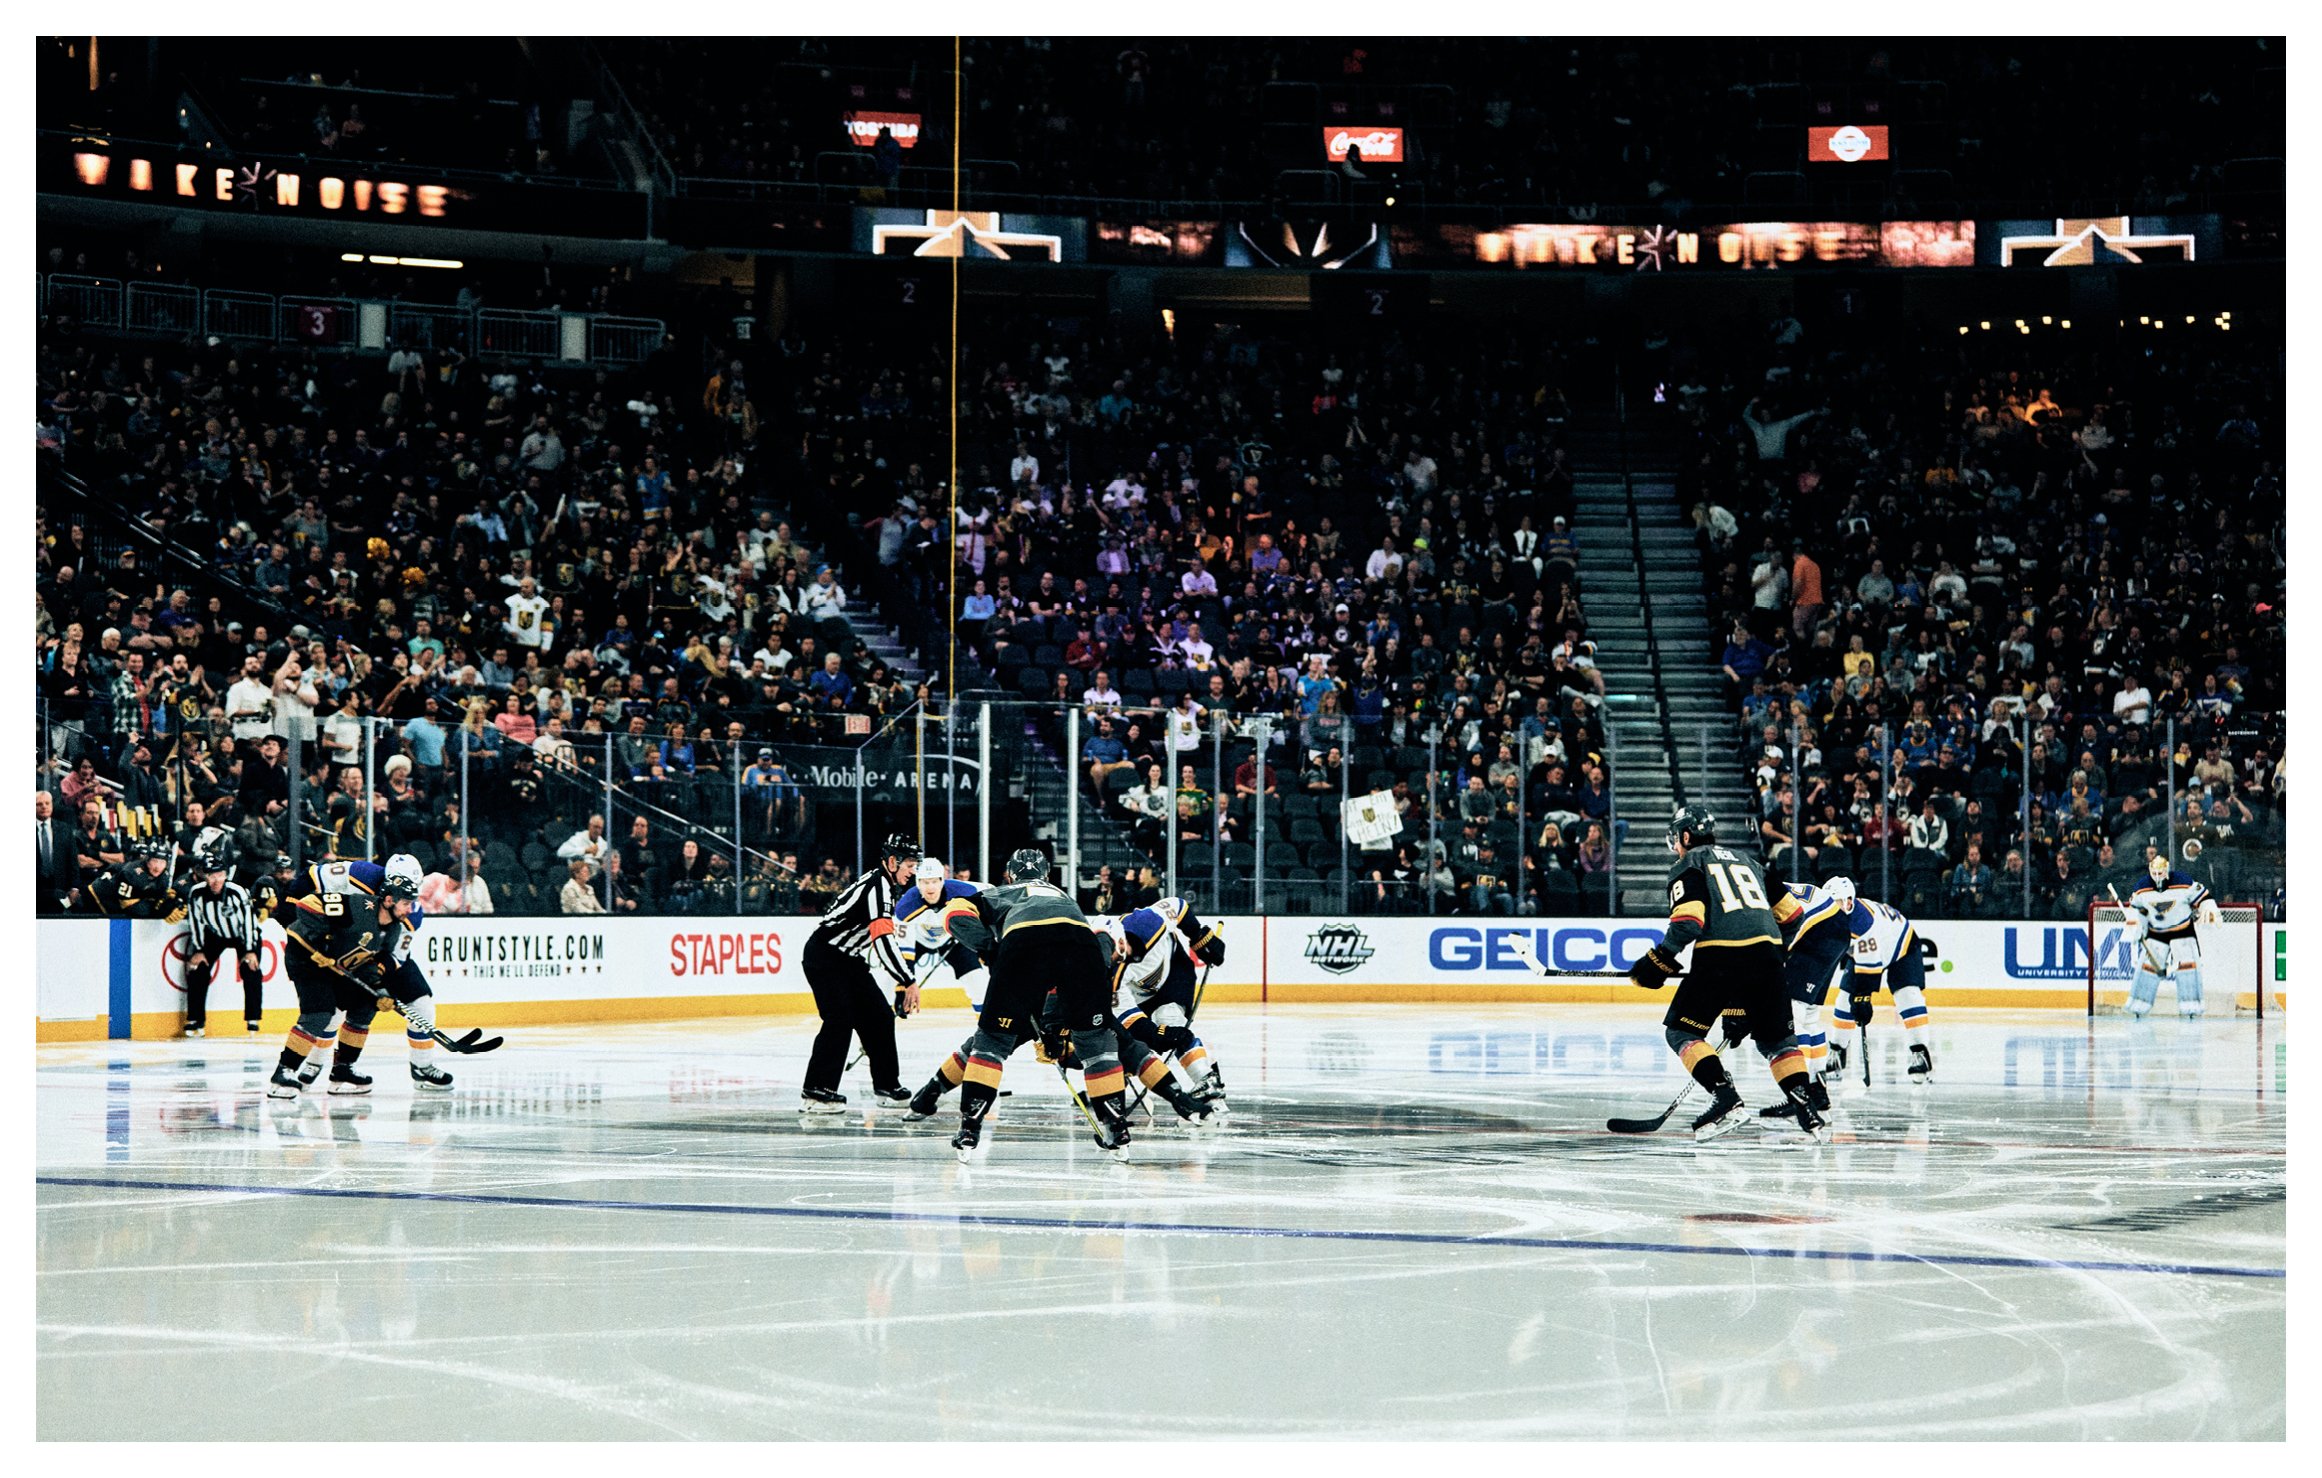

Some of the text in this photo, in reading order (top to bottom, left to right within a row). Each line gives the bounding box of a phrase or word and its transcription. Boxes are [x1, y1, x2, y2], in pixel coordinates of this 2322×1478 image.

[902, 281, 915, 304] 2
[1369, 292, 1384, 316] 2
[312, 311, 326, 336] 3
[894, 771, 972, 790] ARENA
[117, 881, 133, 899] 21
[1707, 863, 1771, 914] 18
[322, 892, 344, 917] 90
[428, 934, 604, 963] GRUNTSTYLE.COM
[670, 932, 783, 977] STAPLES
[1305, 935, 1375, 957] NHL
[1428, 927, 1667, 972] GEICO
[474, 965, 495, 978] THIS
[528, 963, 562, 977] DEFEND
[1313, 956, 1365, 964] NETWORK
[2017, 968, 2082, 977] UNIVERSITY
